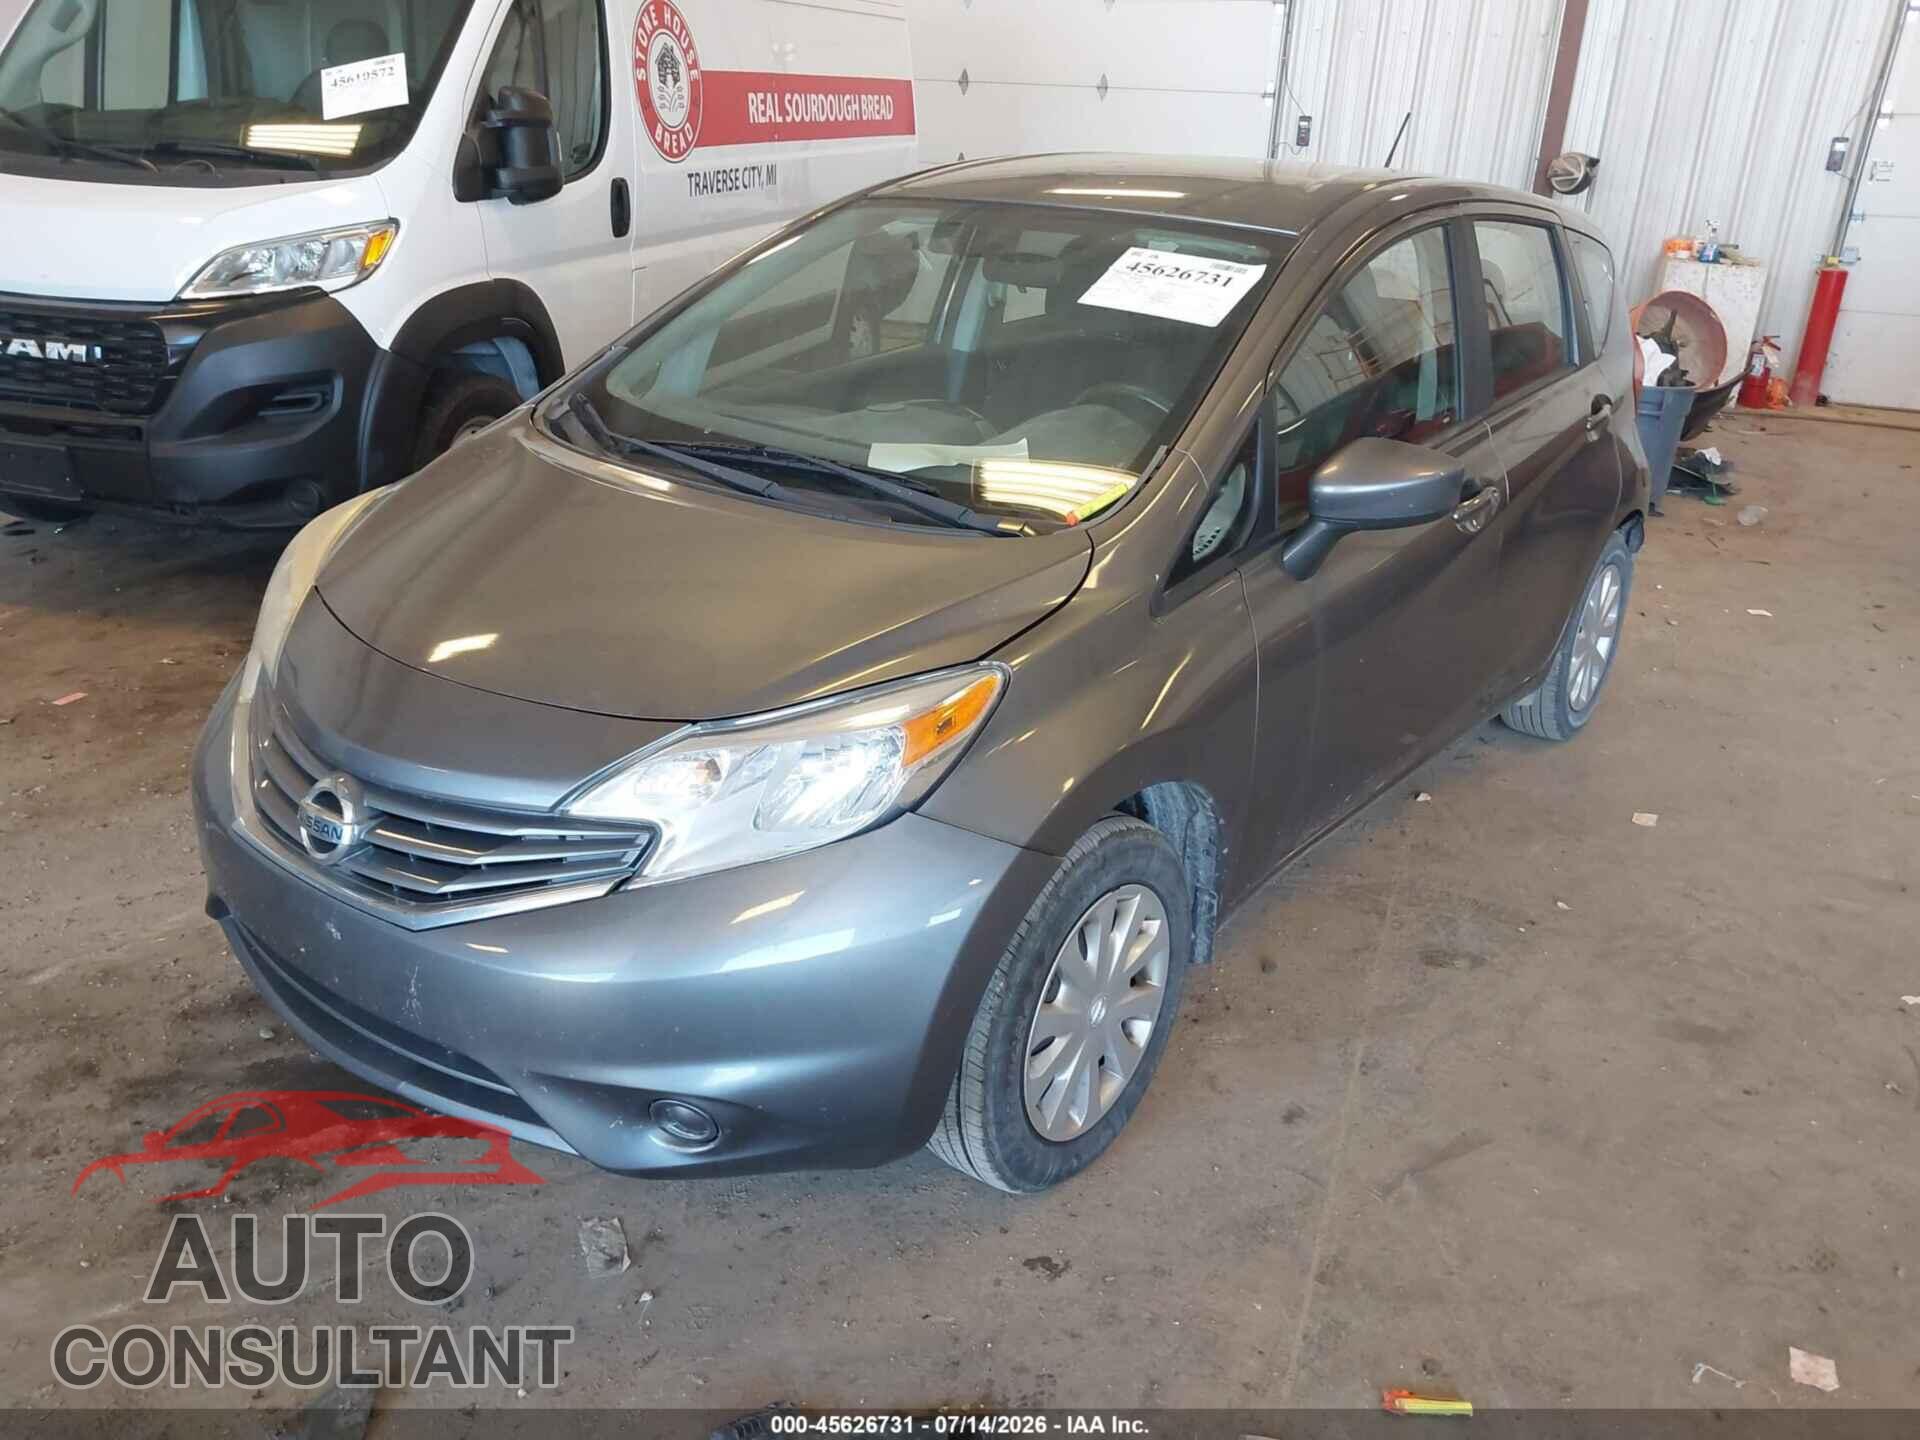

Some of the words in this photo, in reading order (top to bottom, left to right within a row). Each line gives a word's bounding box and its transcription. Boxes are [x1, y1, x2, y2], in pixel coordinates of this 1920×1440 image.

[635, 4, 659, 80] STONE
[664, 5, 698, 81] HOUSE
[748, 92, 783, 123] REAL
[784, 93, 860, 122] SOURDOUGH
[861, 94, 894, 121] BREAD
[654, 122, 694, 154] BREAD
[687, 168, 740, 197] TRAVERSE
[742, 165, 764, 191] CITY,
[766, 163, 777, 185] MI
[1126, 262, 1233, 288] 45626731
[0, 338, 86, 363] AM
